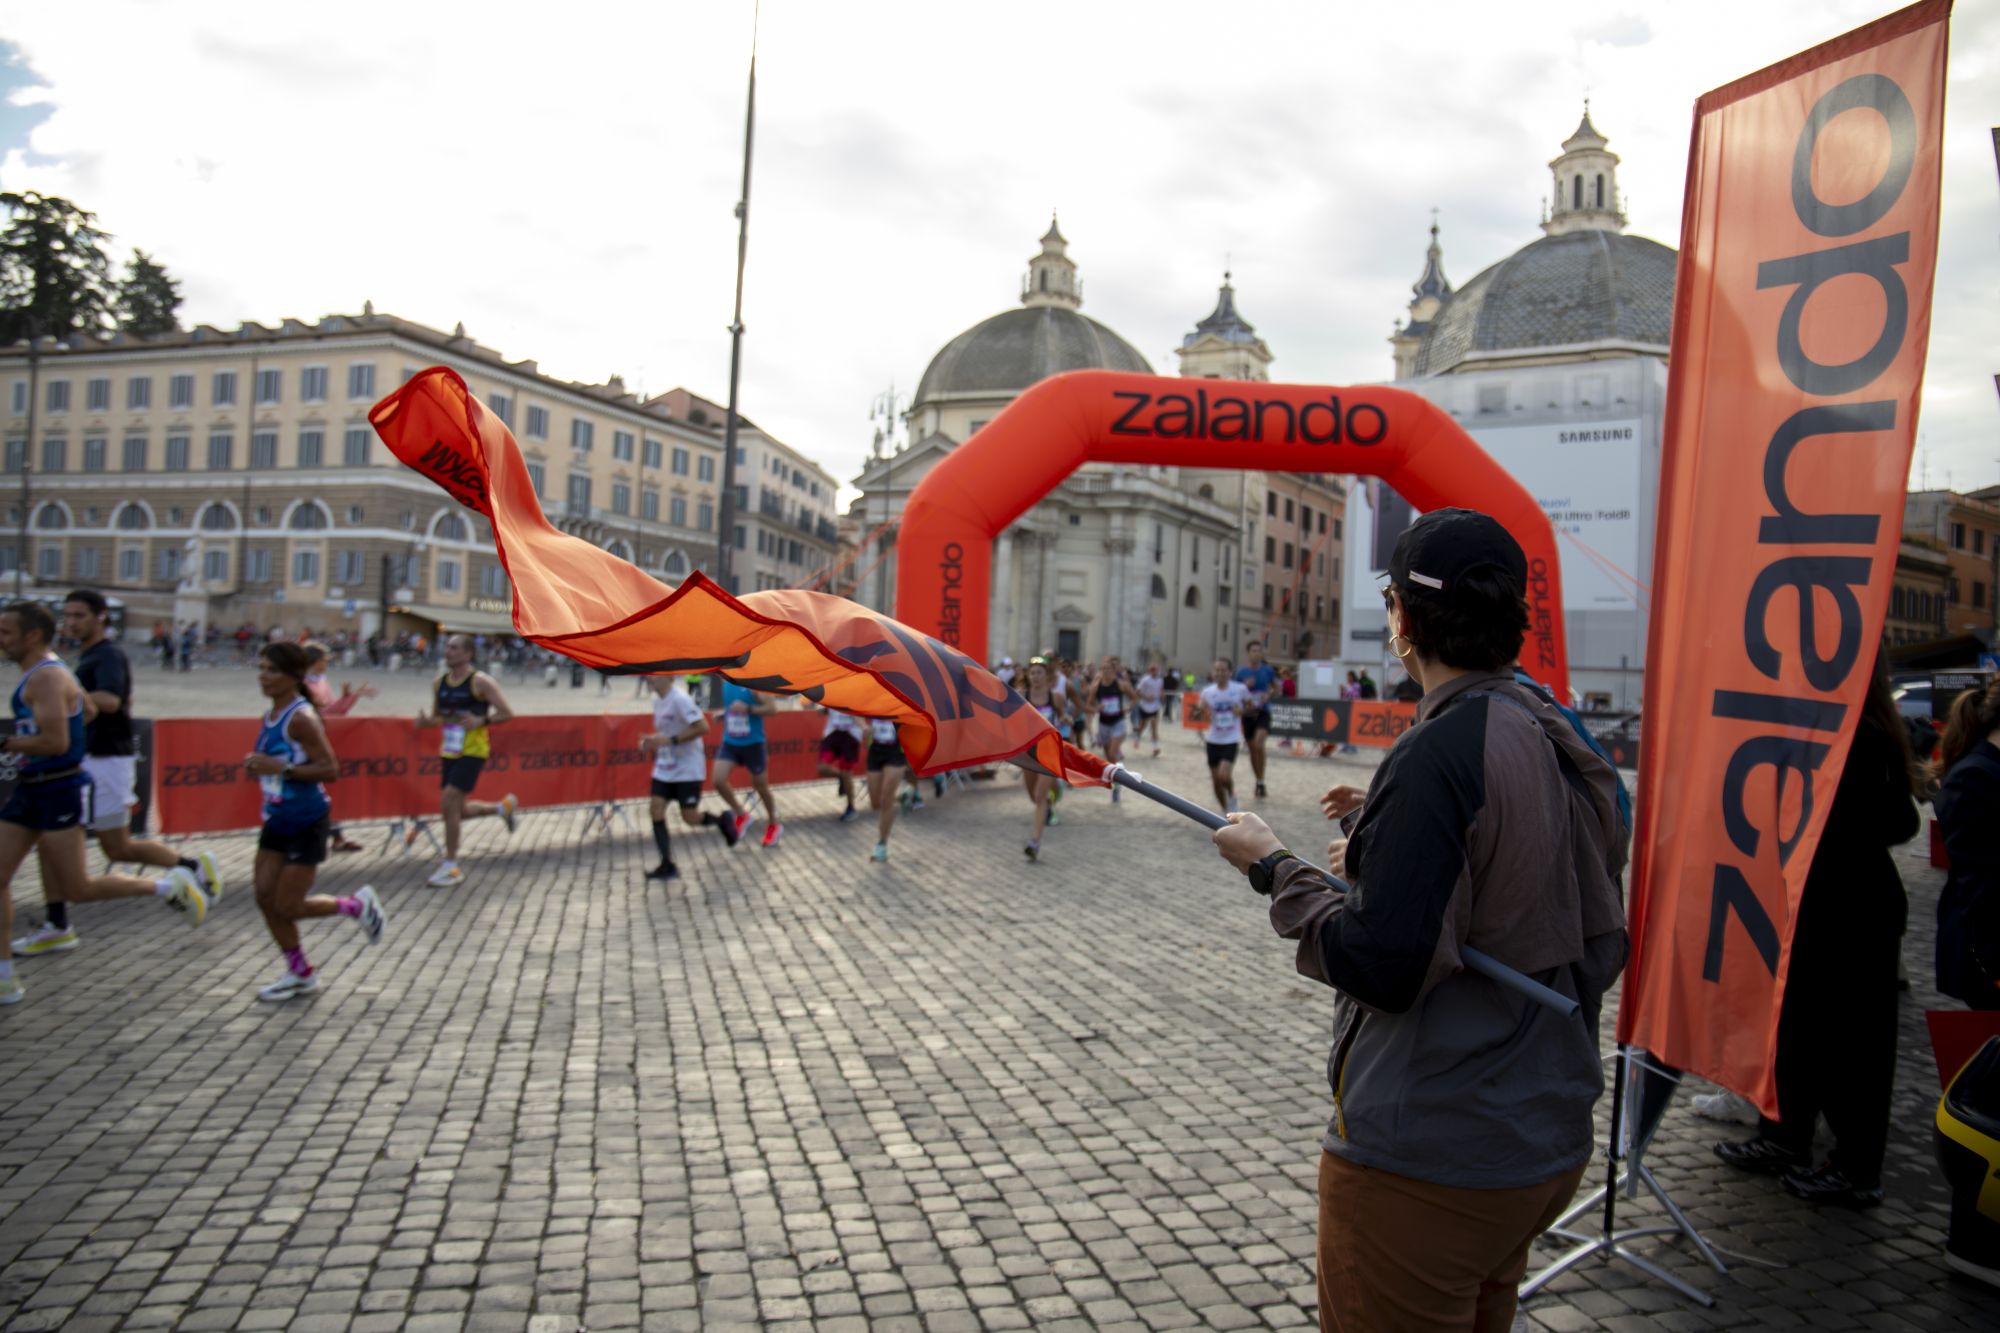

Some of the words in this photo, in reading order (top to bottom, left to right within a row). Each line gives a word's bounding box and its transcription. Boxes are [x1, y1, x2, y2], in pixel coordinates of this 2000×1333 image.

[1109, 388, 1389, 447] zalando
[1559, 428, 1633, 444] SAMSUNG
[1702, 72, 1918, 984] zalando
[937, 542, 963, 649] alando
[1529, 557, 1556, 670] zalando
[1358, 708, 1415, 737] zala
[162, 759, 255, 788] zalan
[338, 752, 407, 779] ando
[519, 749, 599, 772] zalando
